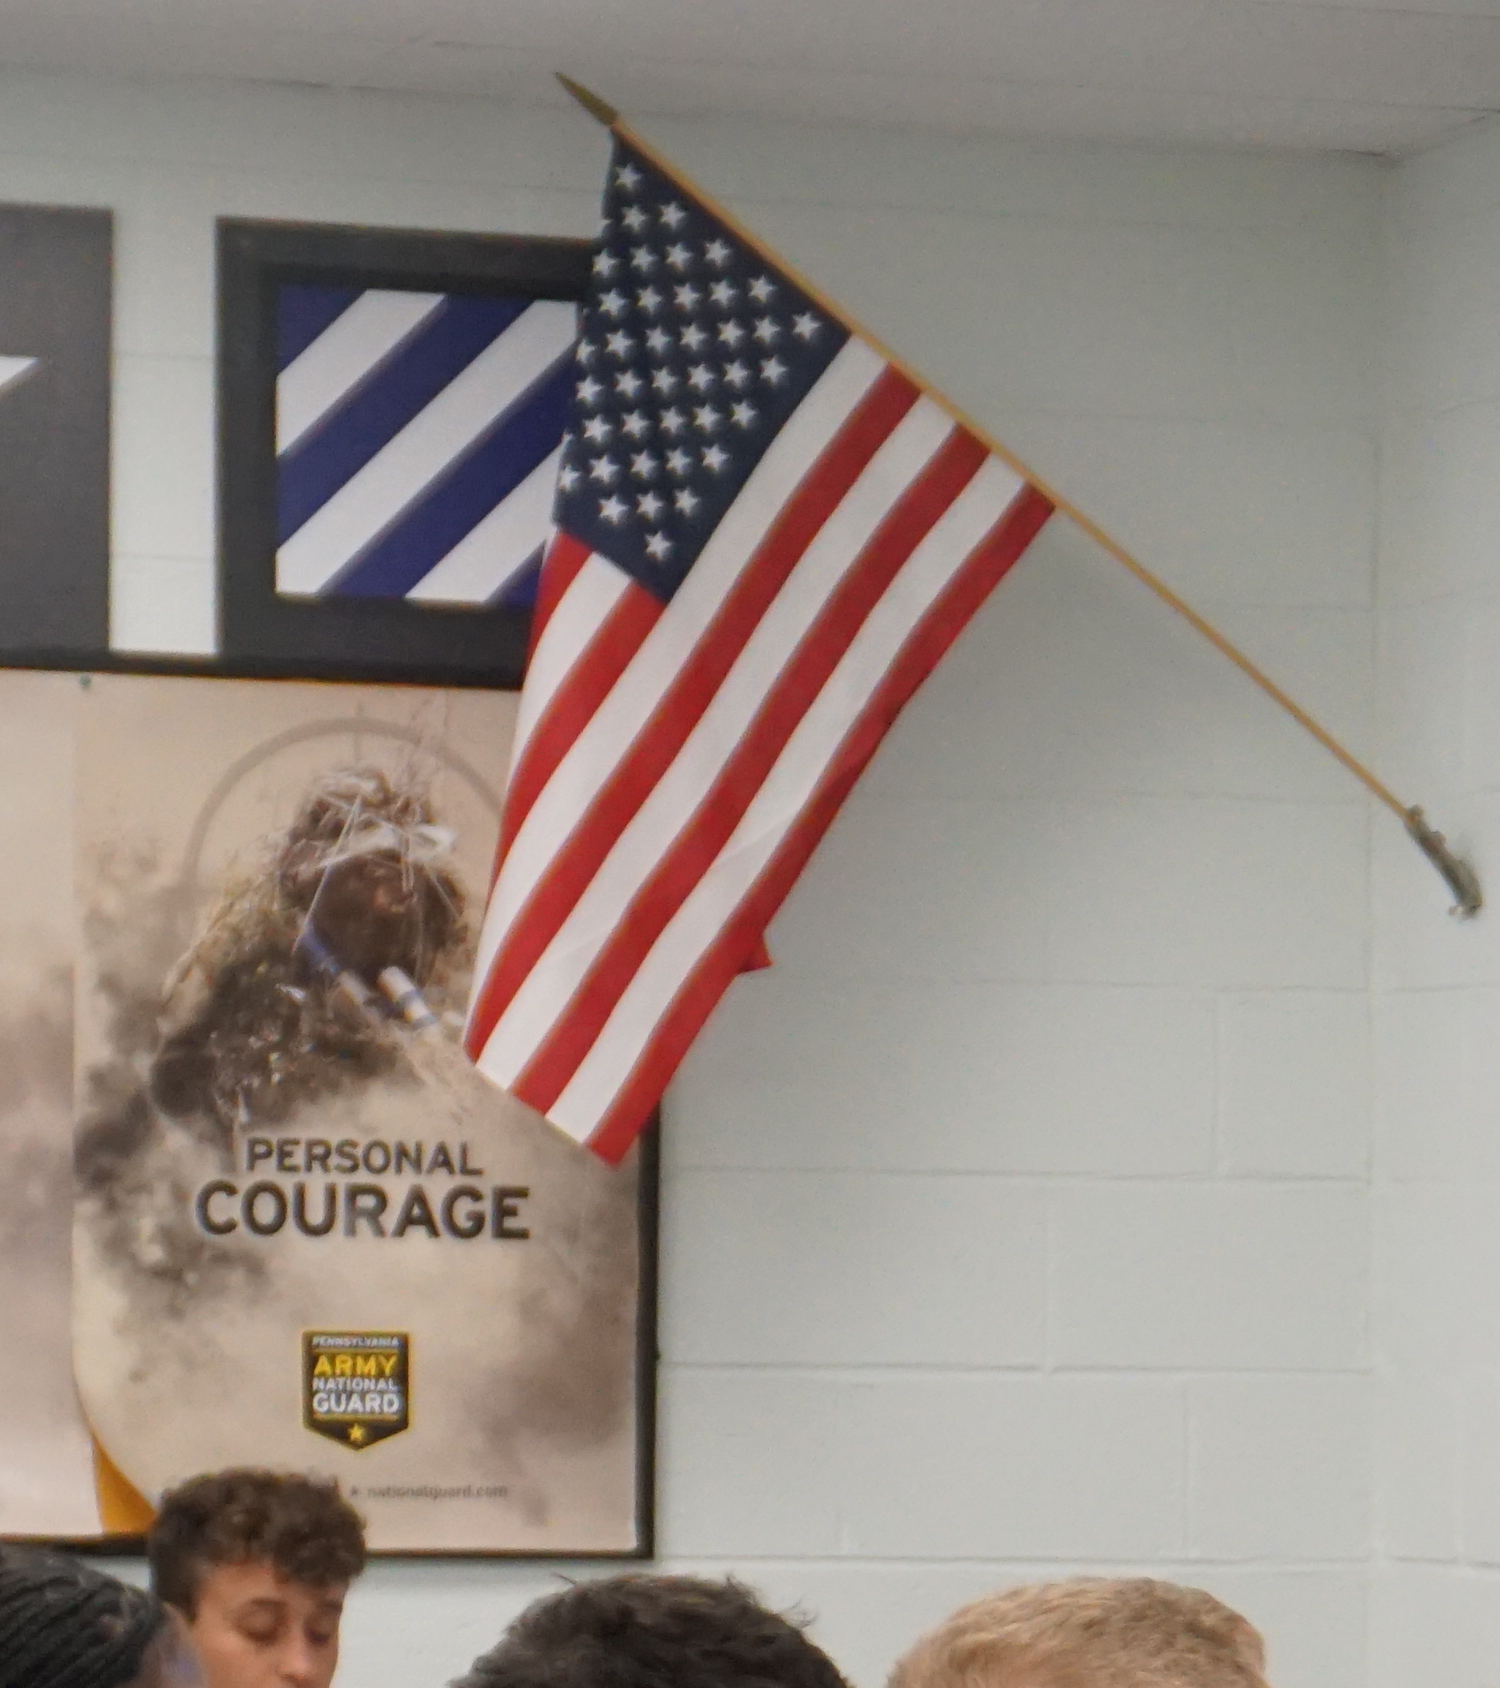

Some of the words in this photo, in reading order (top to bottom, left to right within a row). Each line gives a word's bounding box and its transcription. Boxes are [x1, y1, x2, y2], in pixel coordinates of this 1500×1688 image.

[246, 1136, 485, 1177] PERSONAL
[196, 1179, 531, 1240] COURAGE
[313, 1353, 398, 1377] ARMY
[312, 1377, 399, 1392] NATIONAL
[312, 1392, 400, 1414] GUARD
